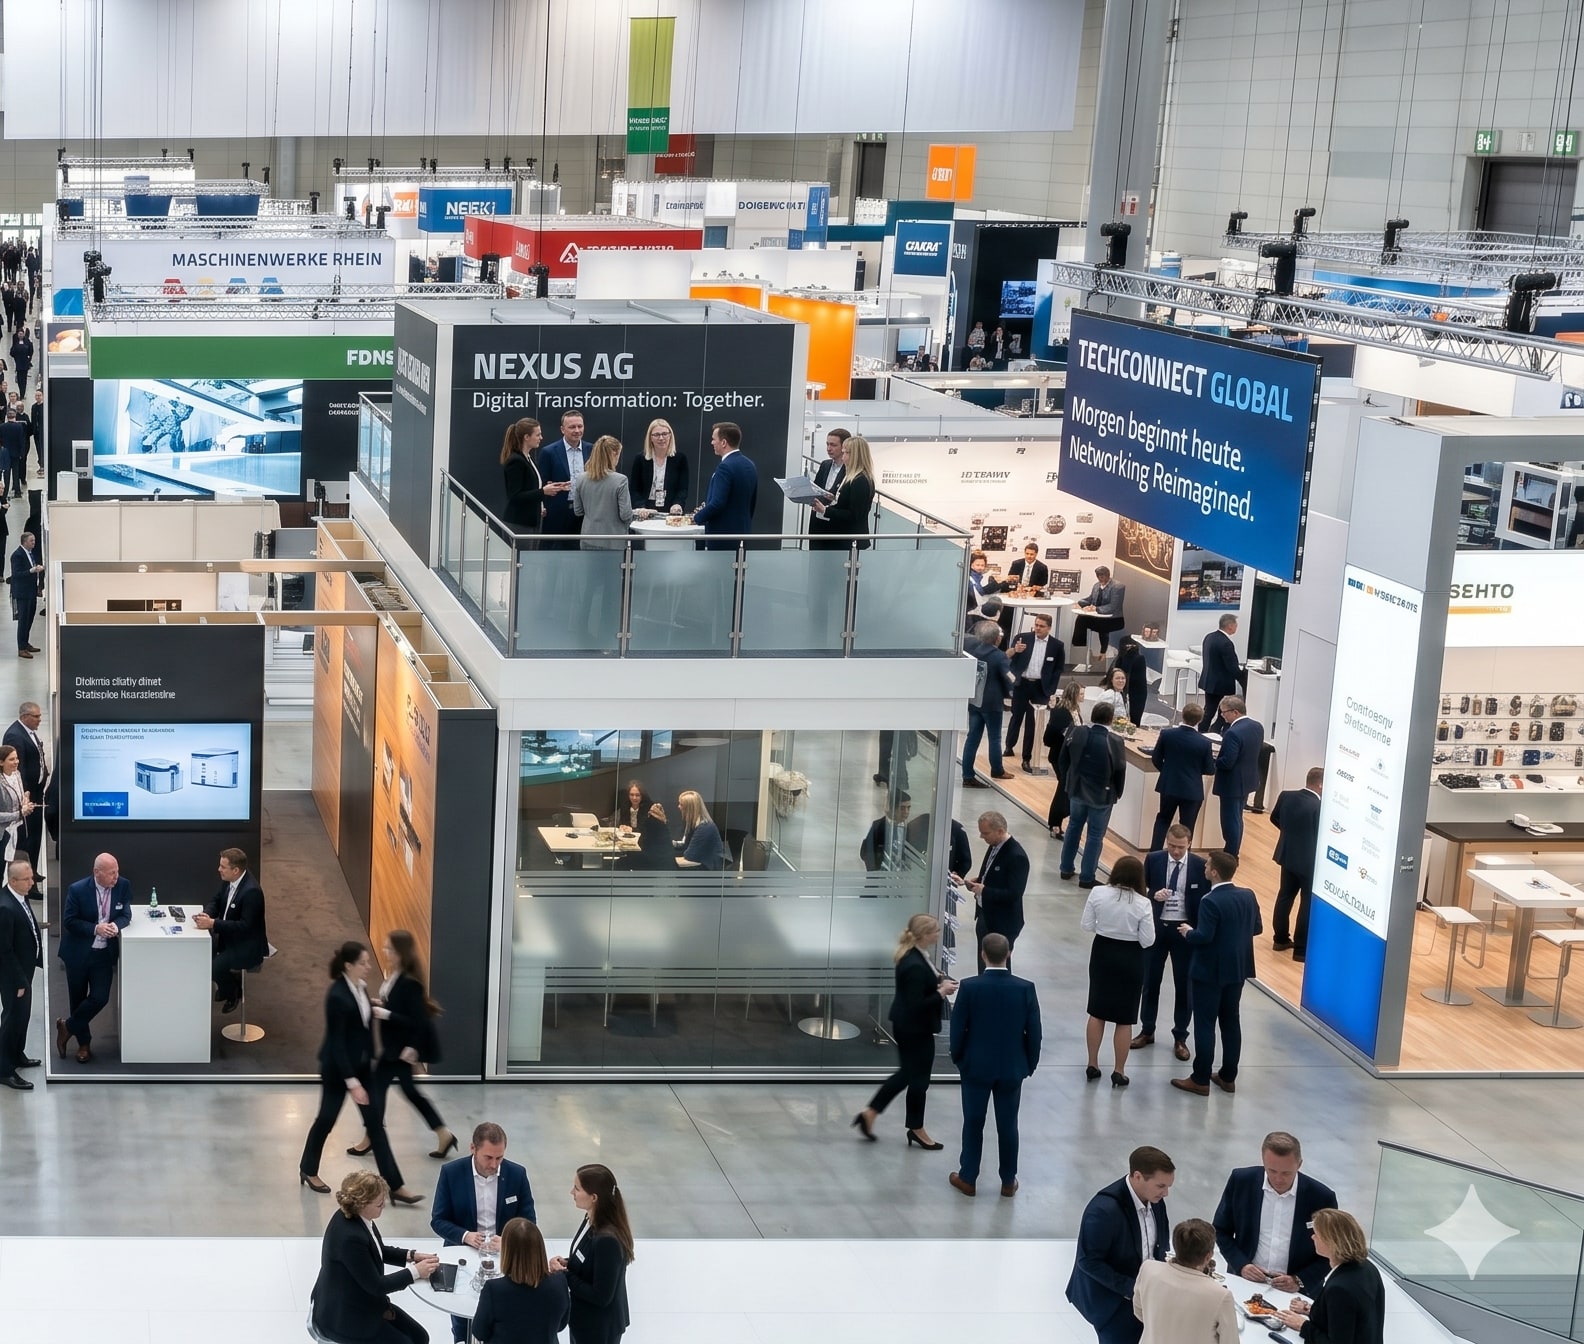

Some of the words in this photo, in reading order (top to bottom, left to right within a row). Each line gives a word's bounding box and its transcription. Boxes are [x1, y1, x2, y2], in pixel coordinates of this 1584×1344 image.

[172, 252, 327, 267] MASCHINENWERKE
[333, 252, 382, 266] RHEIN
[473, 352, 582, 380] NEXUS
[590, 352, 634, 380] AG
[1078, 339, 1207, 398] TECHCONNECT
[1210, 371, 1293, 423] GLOBAL
[472, 391, 529, 412] Digital
[535, 391, 677, 408] Transformation:
[682, 391, 765, 412] Together.
[1071, 396, 1124, 437] Morgen
[1128, 410, 1186, 456] beginnt
[1192, 428, 1245, 473] heute.
[1069, 435, 1151, 493] Networking
[1153, 462, 1255, 522] Reimagined.
